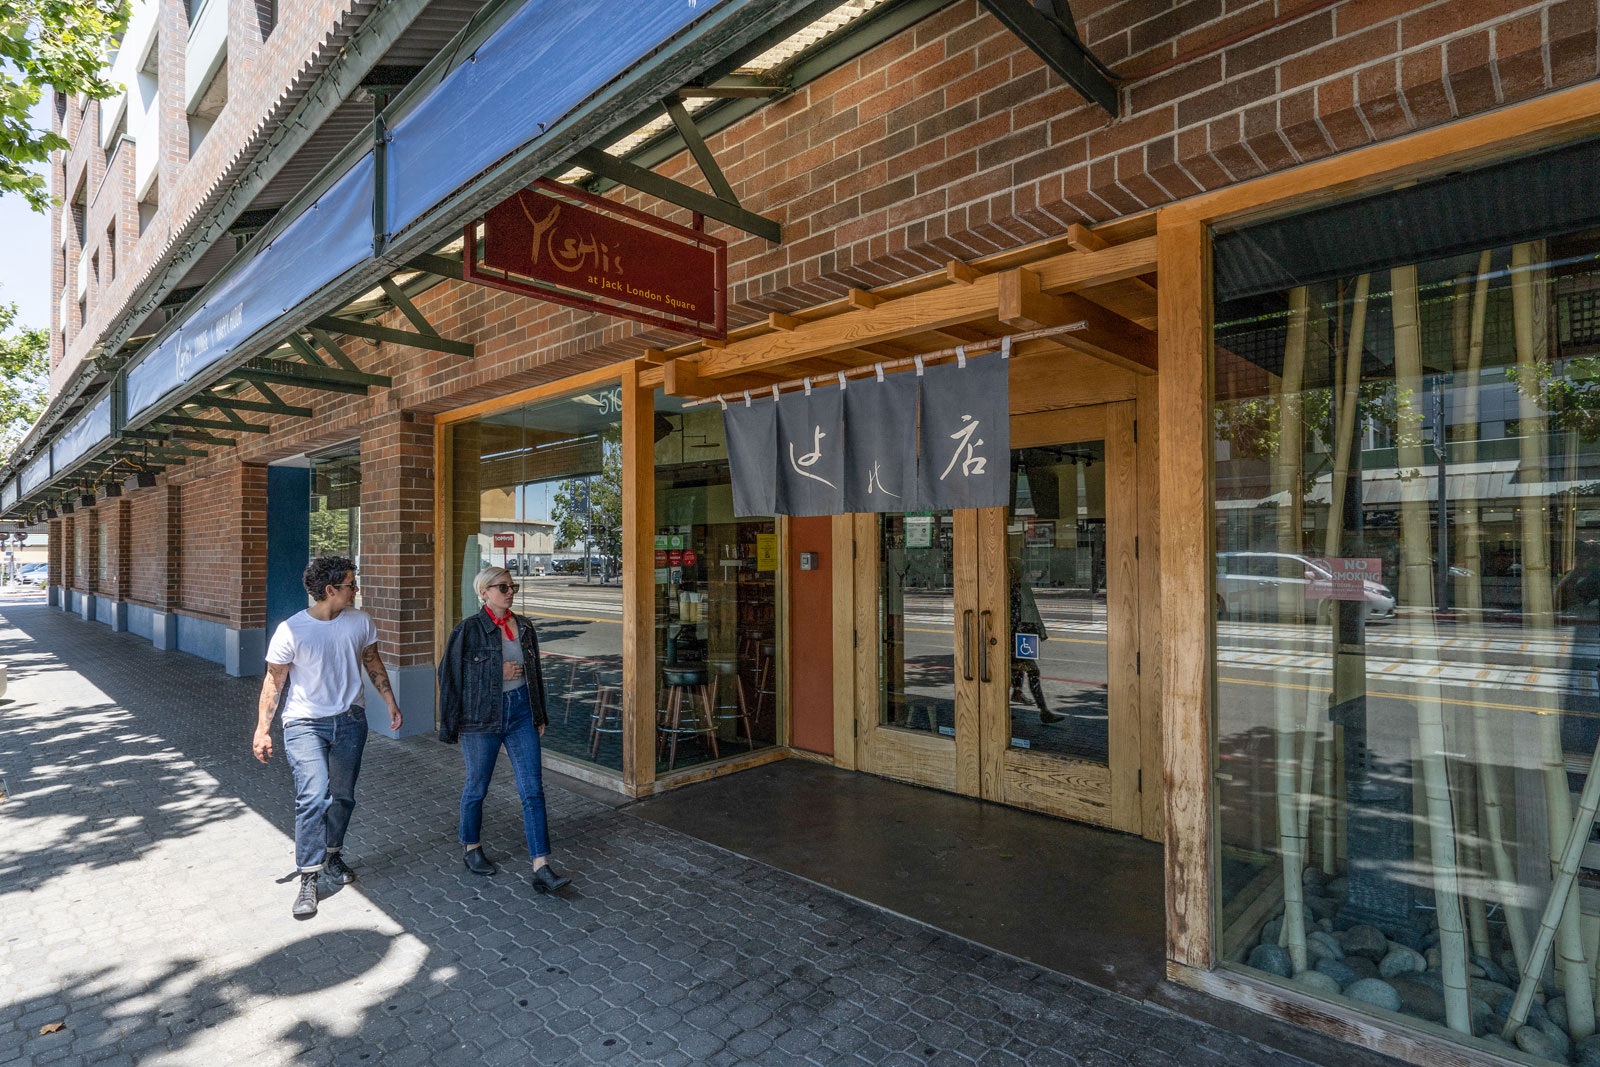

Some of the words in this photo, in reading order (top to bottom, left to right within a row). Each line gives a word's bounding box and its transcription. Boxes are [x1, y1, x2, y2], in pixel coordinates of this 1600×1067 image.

[588, 275, 598, 285] at
[602, 277, 623, 291] Jack
[626, 284, 662, 302] London
[665, 294, 696, 311] Square
[599, 387, 623, 415] 510
[1344, 559, 1368, 570] NO
[1332, 571, 1380, 582] SMOKING
